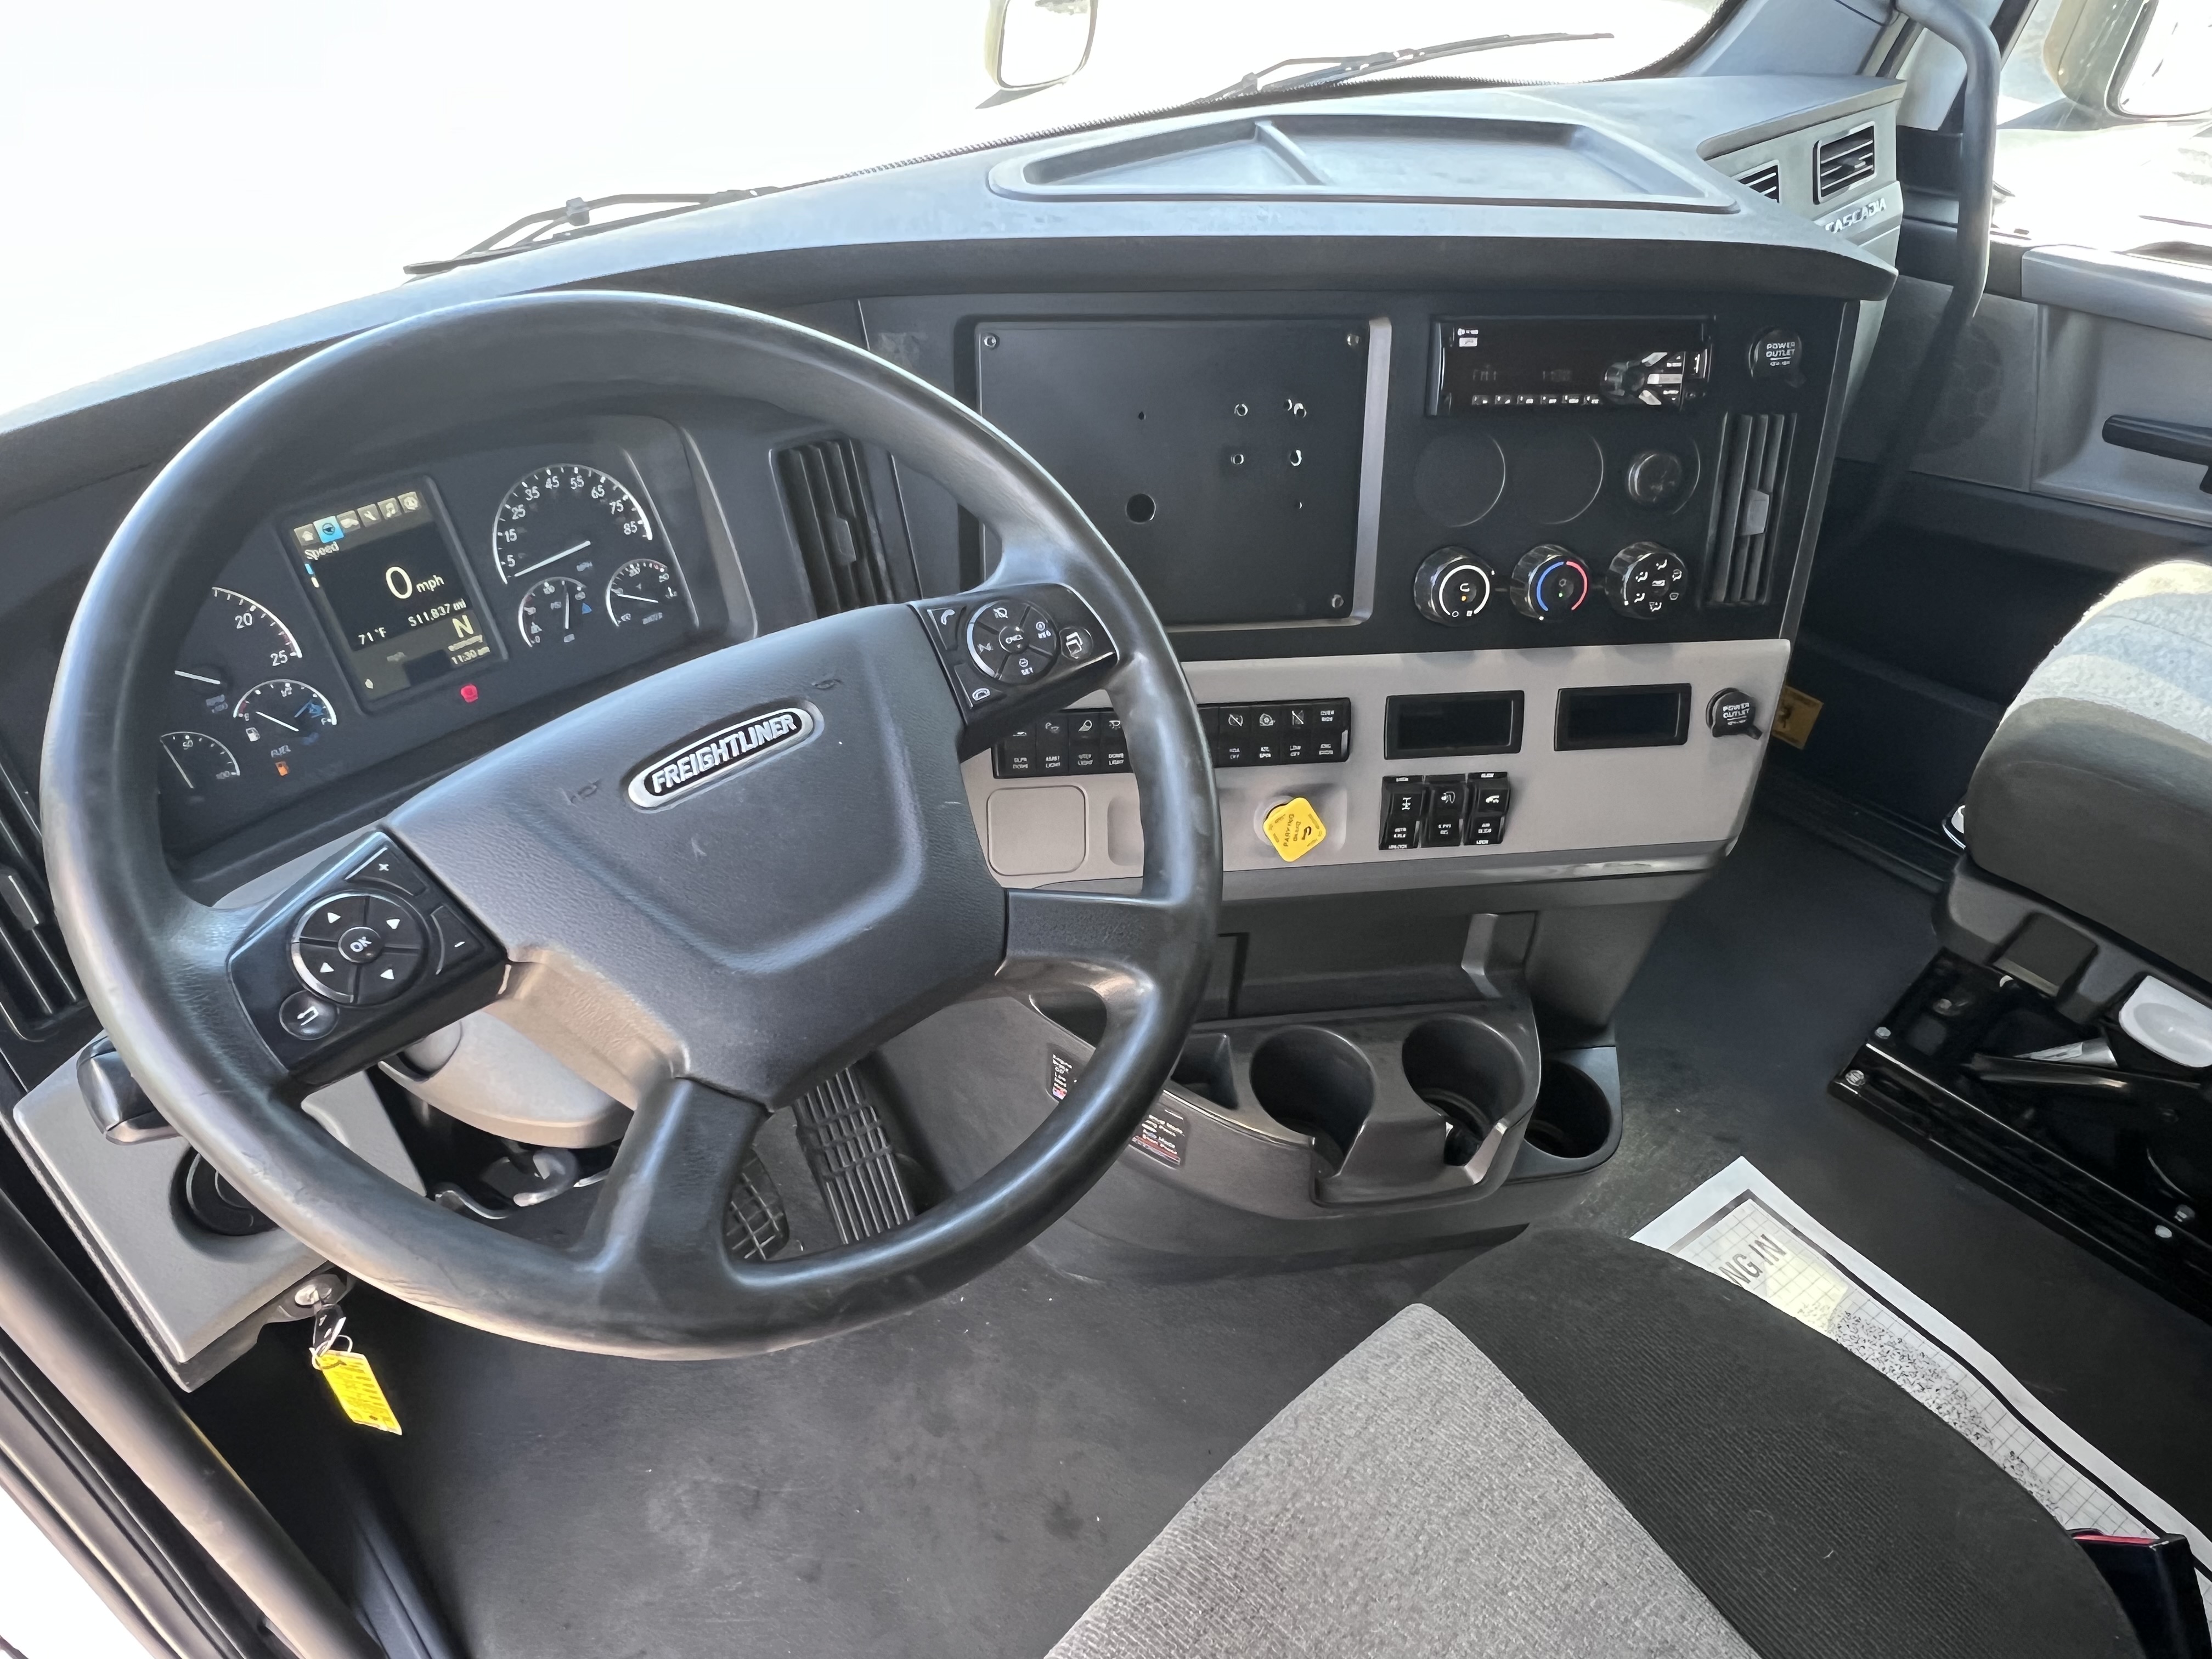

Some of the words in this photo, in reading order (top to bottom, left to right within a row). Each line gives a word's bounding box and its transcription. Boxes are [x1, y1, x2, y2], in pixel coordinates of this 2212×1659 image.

[1767, 341, 1795, 350] POWER
[1766, 349, 1795, 358] OUTLET
[545, 476, 560, 489] 45
[570, 475, 585, 490] 55
[591, 484, 605, 499] 65
[511, 504, 527, 520] 25
[609, 499, 624, 515] 75
[505, 528, 517, 542] 15
[623, 521, 638, 536] 85
[304, 540, 340, 561] Speed
[507, 554, 516, 567] 5
[385, 566, 413, 600] 0
[416, 574, 445, 594] mph
[235, 612, 253, 629] 20
[452, 614, 474, 638] N
[358, 632, 374, 645] 71
[270, 650, 288, 667] 25
[1723, 702, 1750, 712] POWER
[1723, 708, 1750, 718] OUTLET
[651, 714, 797, 794] FREIGHTLINER
[350, 935, 373, 953] OK
[1714, 1254, 1763, 1288] NG
[1748, 1234, 1787, 1266] IN
